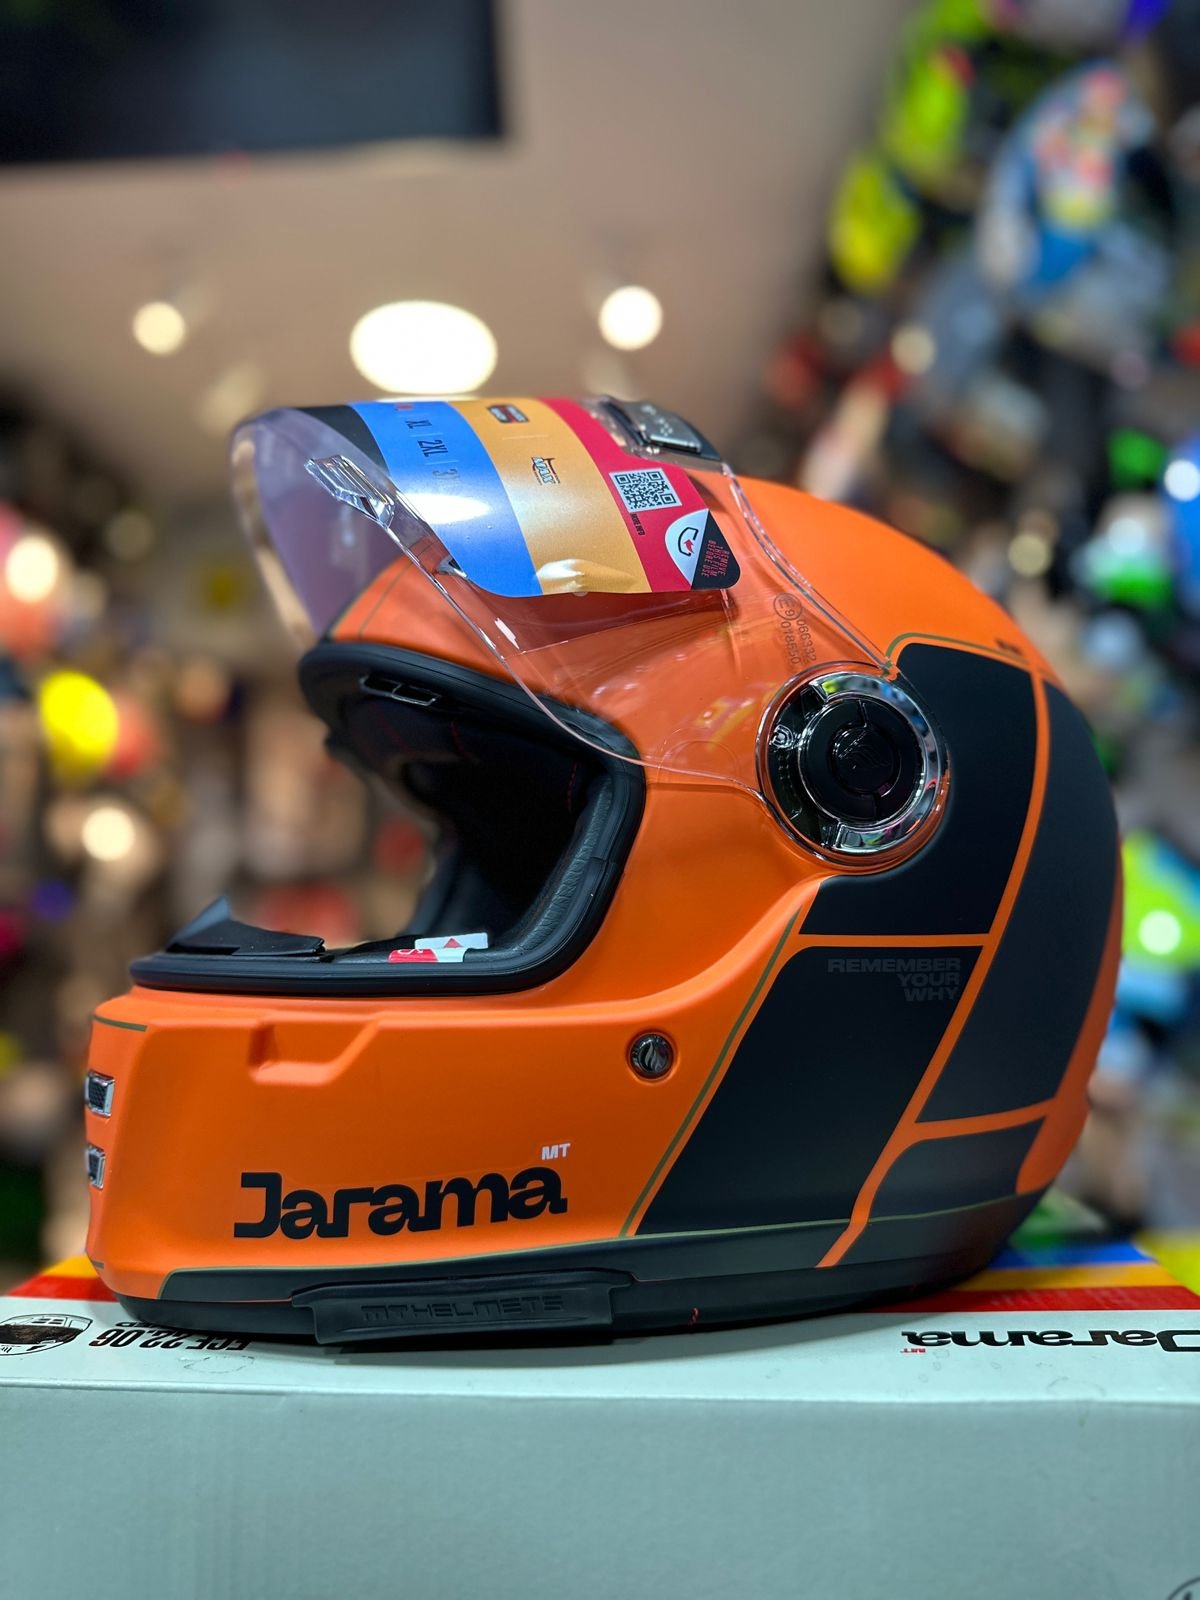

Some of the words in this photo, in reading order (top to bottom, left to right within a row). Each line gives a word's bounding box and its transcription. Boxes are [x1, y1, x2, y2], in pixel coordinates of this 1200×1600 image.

[417, 439, 448, 457] 2XL
[704, 540, 717, 564] BEFORE
[712, 545, 723, 560] THIS
[701, 564, 711, 578] USE
[709, 559, 720, 577] FILM
[717, 550, 730, 576] REMOVE
[827, 958, 961, 973] REMEMBER
[897, 972, 960, 988] YOUR
[904, 987, 958, 1002] WHY
[541, 1143, 570, 1160] MT
[233, 1166, 568, 1240] Jarama
